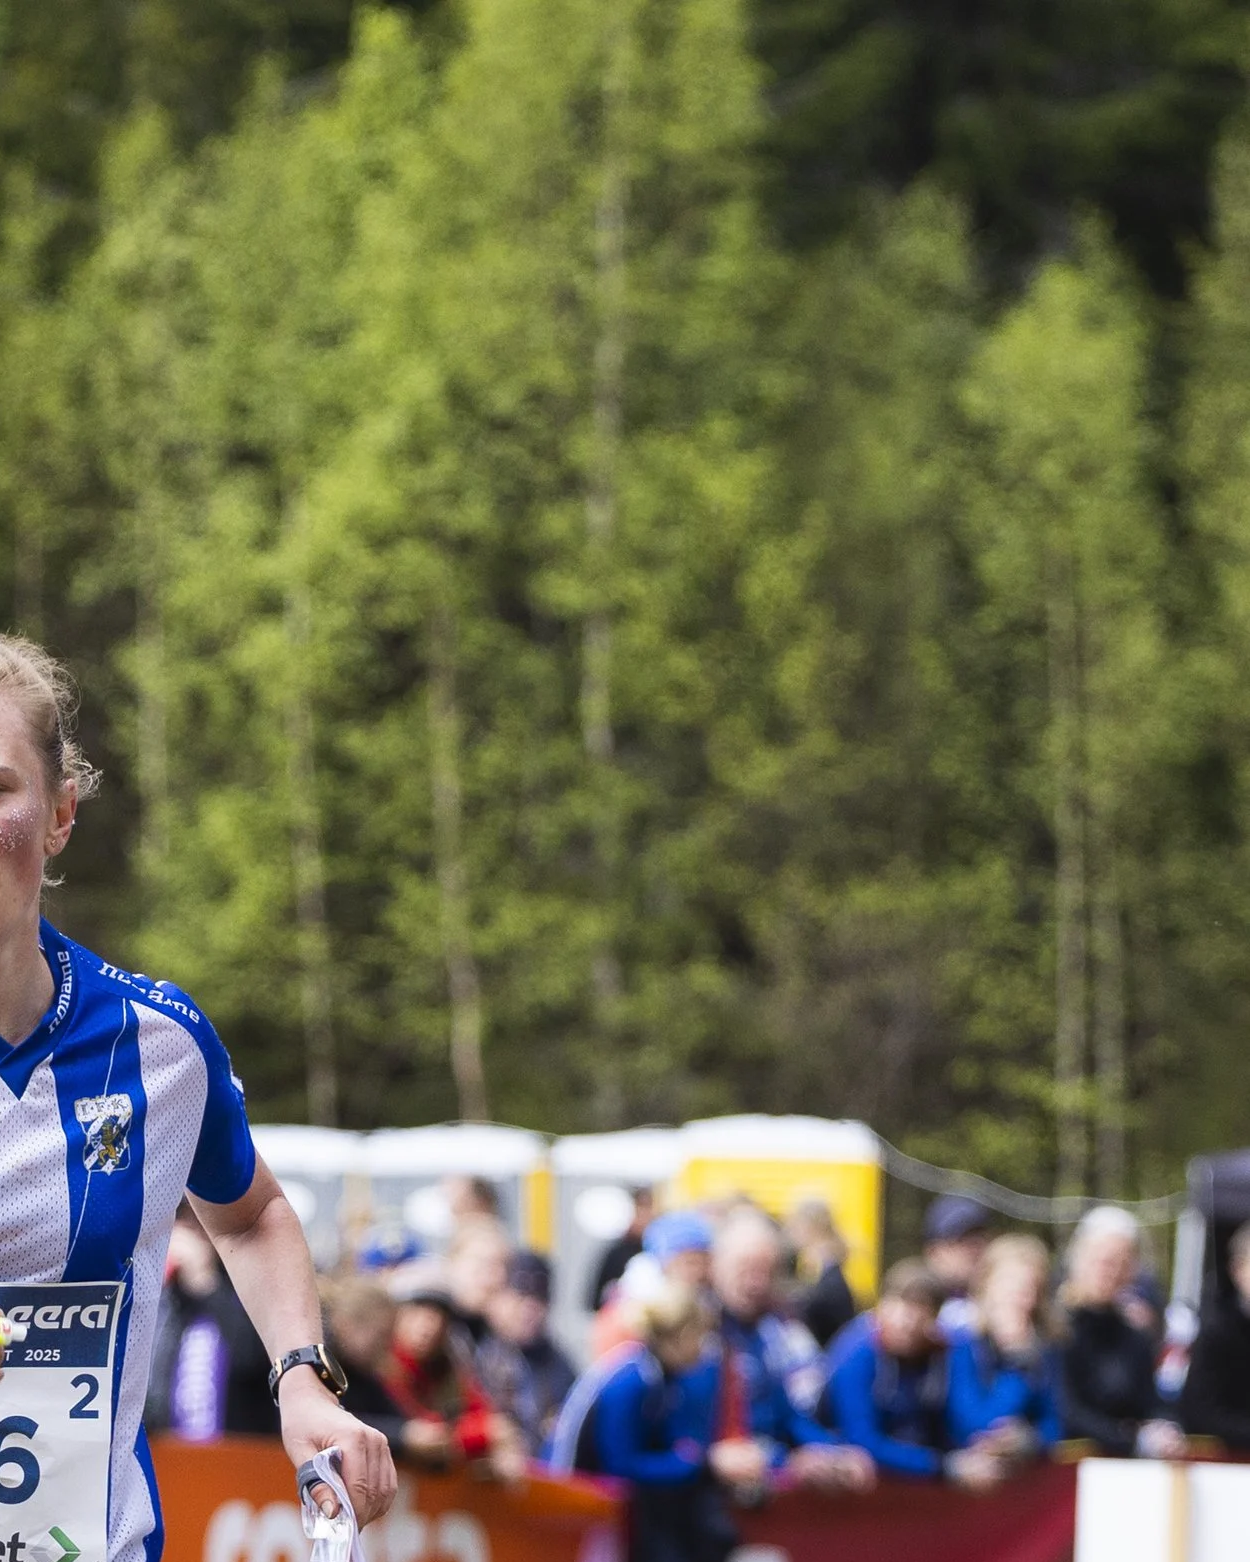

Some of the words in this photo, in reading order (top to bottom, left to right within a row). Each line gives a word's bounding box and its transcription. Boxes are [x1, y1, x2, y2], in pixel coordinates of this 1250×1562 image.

[49, 950, 73, 1035] noname
[24, 1349, 61, 1362] 2025
[69, 1373, 100, 1419] 2
